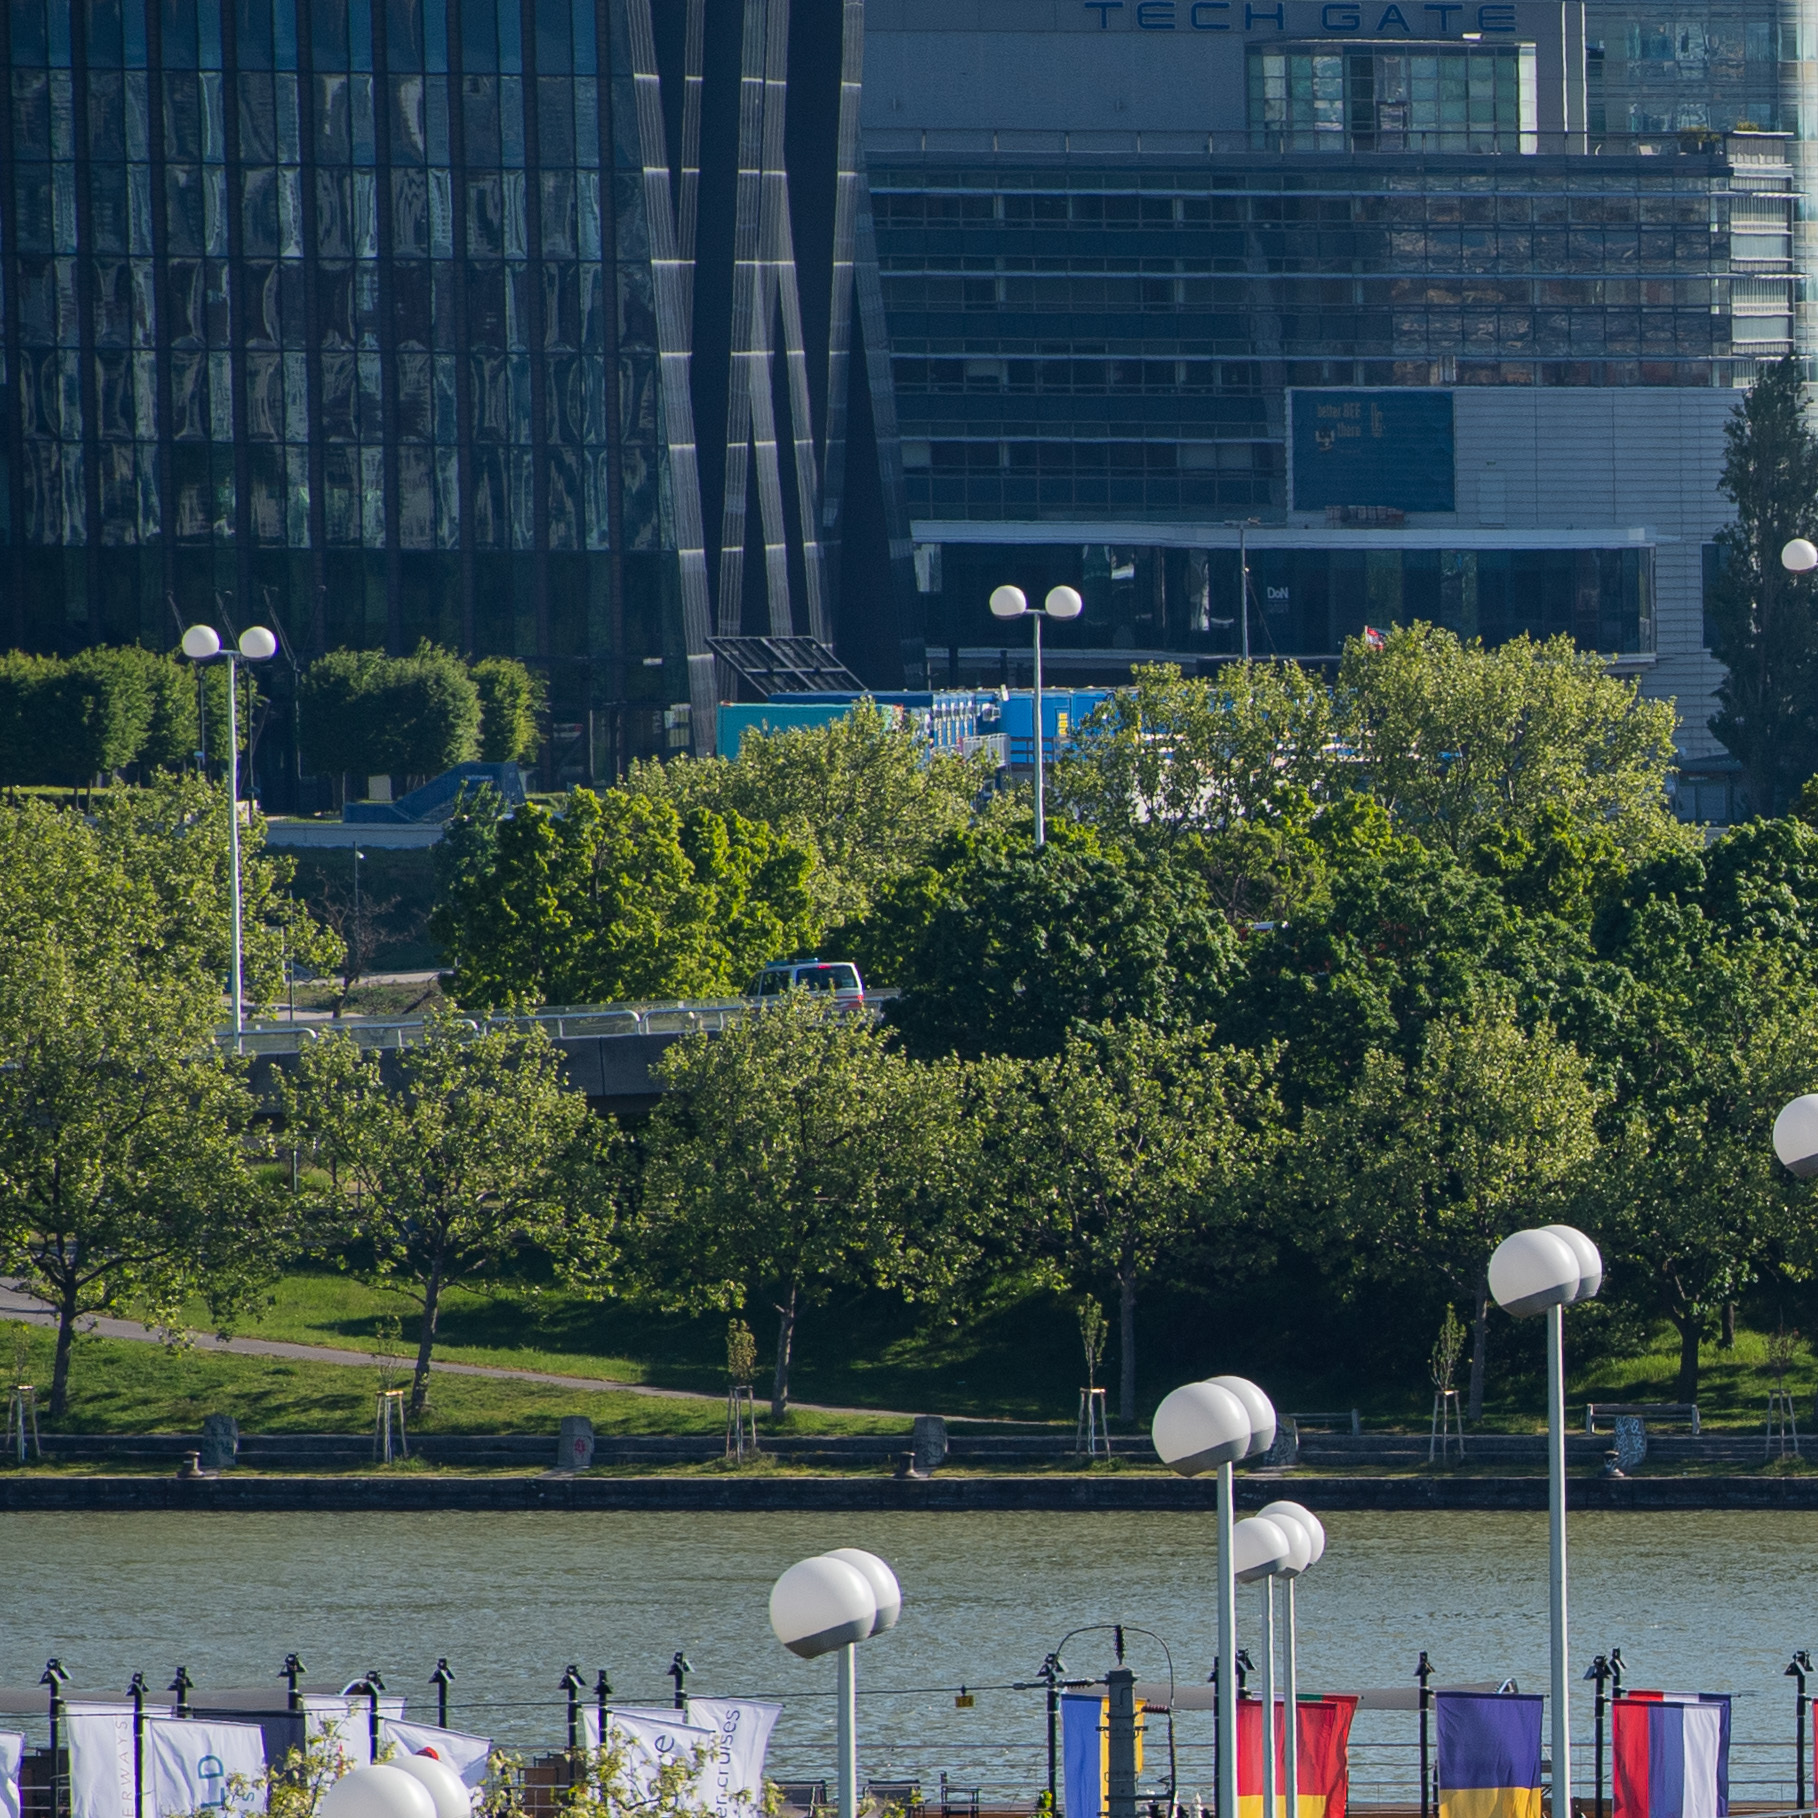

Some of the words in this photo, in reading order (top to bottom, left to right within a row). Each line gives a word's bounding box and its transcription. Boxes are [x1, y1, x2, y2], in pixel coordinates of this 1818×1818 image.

[1085, 2, 1284, 30] TECH
[1321, 4, 1516, 33] GATE
[716, 1709, 741, 1788] cruises
